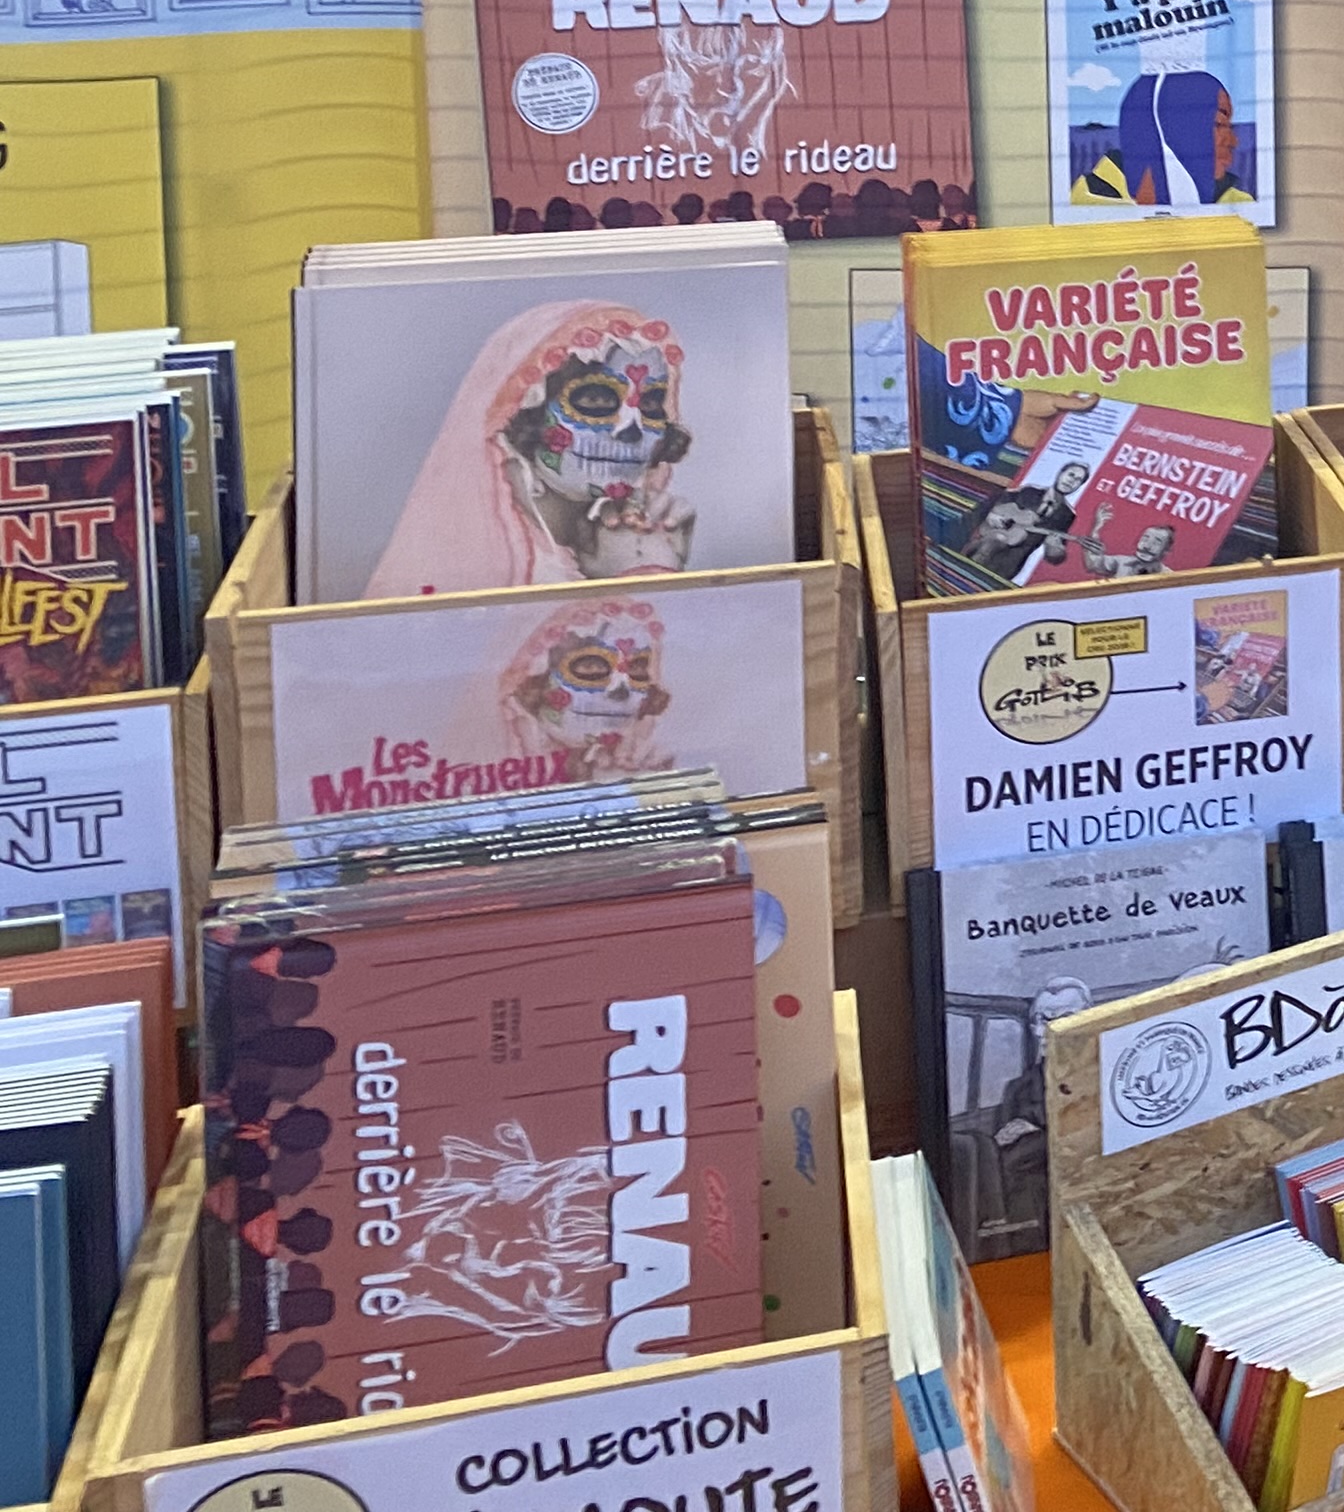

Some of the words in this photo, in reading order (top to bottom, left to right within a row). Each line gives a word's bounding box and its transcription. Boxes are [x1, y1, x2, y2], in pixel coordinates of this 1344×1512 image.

[565, 143, 712, 186] derrière
[729, 143, 759, 177] le
[782, 138, 898, 177] rideau
[988, 266, 1202, 330] VARIÉTÉ
[945, 319, 1245, 386] FRANÇAISE
[1112, 442, 1248, 499] BERNSTEIN
[1097, 479, 1114, 493] ET
[1116, 474, 1231, 528] GEFFROY
[1024, 652, 1069, 671] PRIX
[1036, 632, 1057, 648] LE
[371, 735, 431, 777] Les
[965, 756, 1123, 814] DAMIEN
[1134, 734, 1316, 796] GEFFROY
[1027, 819, 1072, 852] EN
[1079, 794, 1240, 846] DÉDICACE
[967, 903, 1112, 941] Banquette
[1125, 891, 1158, 918] de
[355, 1041, 414, 1248] derrière
[360, 1271, 408, 1318] le
